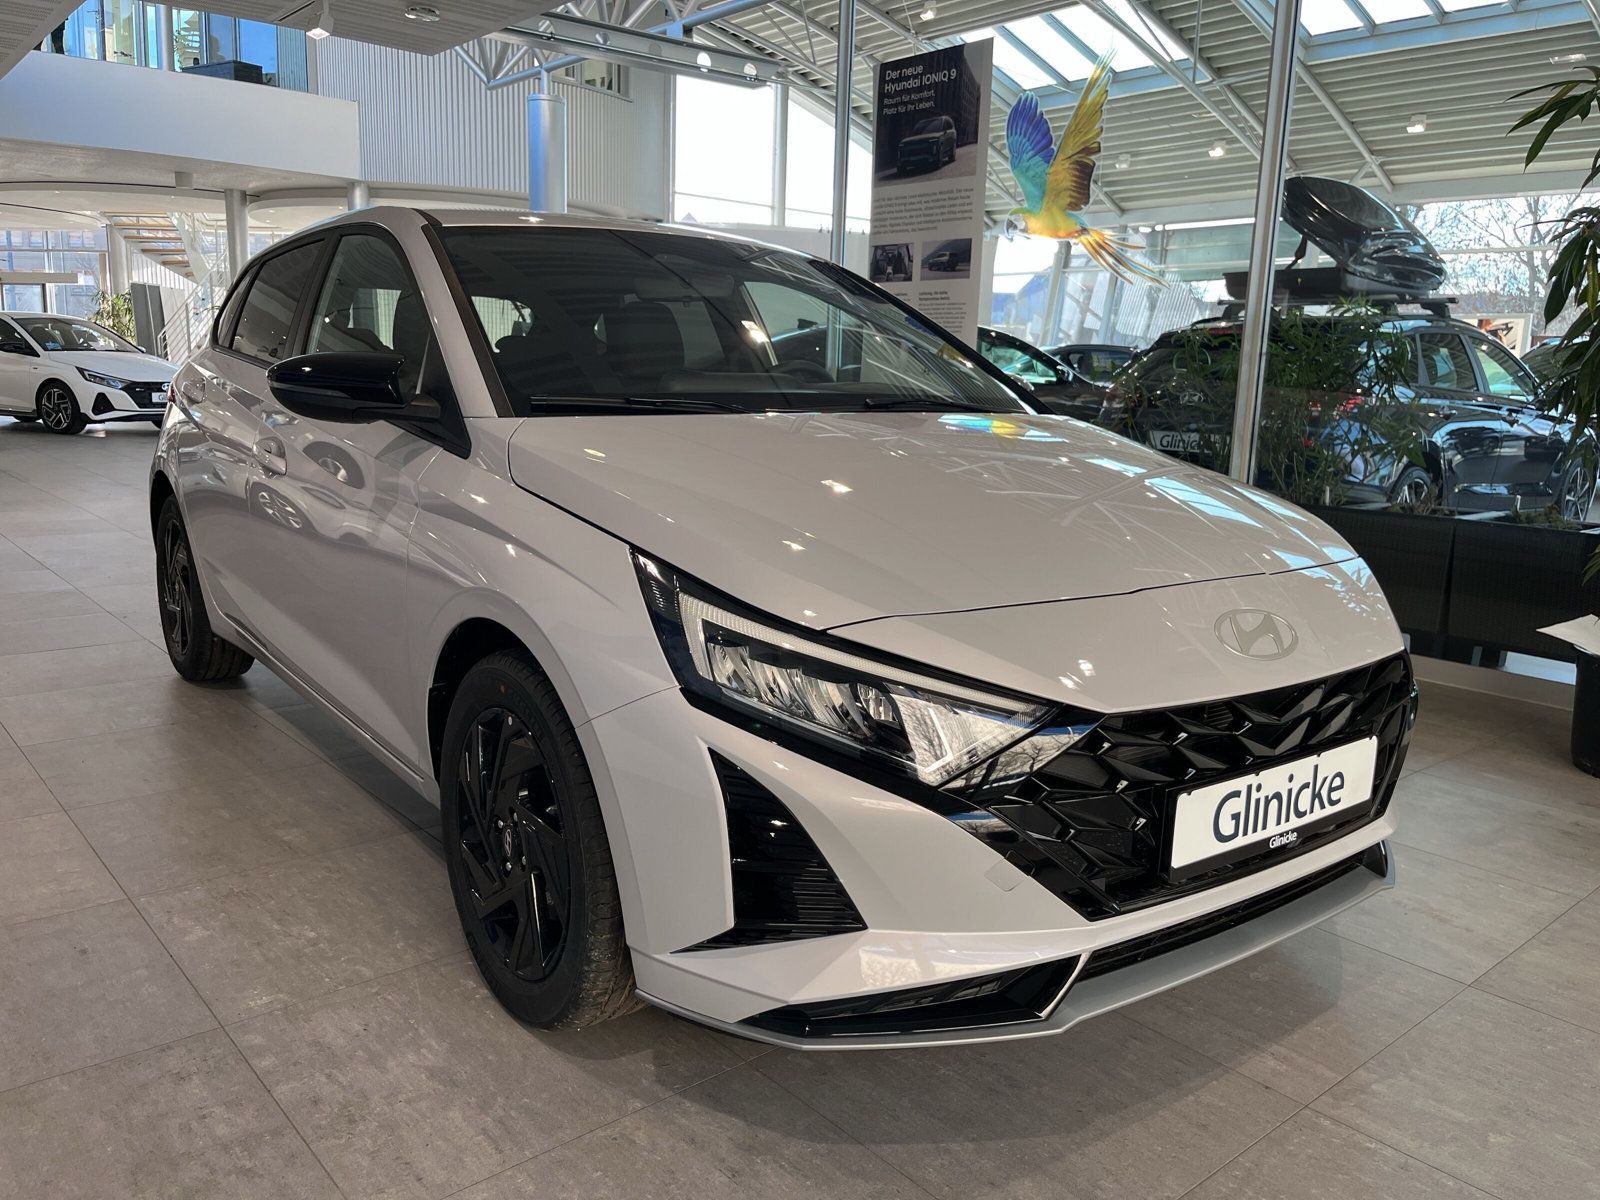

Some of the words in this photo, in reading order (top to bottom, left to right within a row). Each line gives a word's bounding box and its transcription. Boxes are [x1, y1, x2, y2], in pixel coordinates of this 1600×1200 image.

[885, 70, 900, 80] Der
[902, 65, 924, 77] neue
[885, 76, 921, 94] Hyundai
[922, 70, 949, 85] IONIQ
[950, 68, 957, 79] 9
[883, 107, 898, 115] Platz
[898, 104, 907, 113] für
[916, 100, 935, 110] Leben.
[884, 97, 901, 105] Raum
[902, 94, 910, 102] für
[1160, 433, 1202, 451] Glinic
[1213, 764, 1345, 843] Glinicke
[1269, 831, 1298, 849] Glinicke
